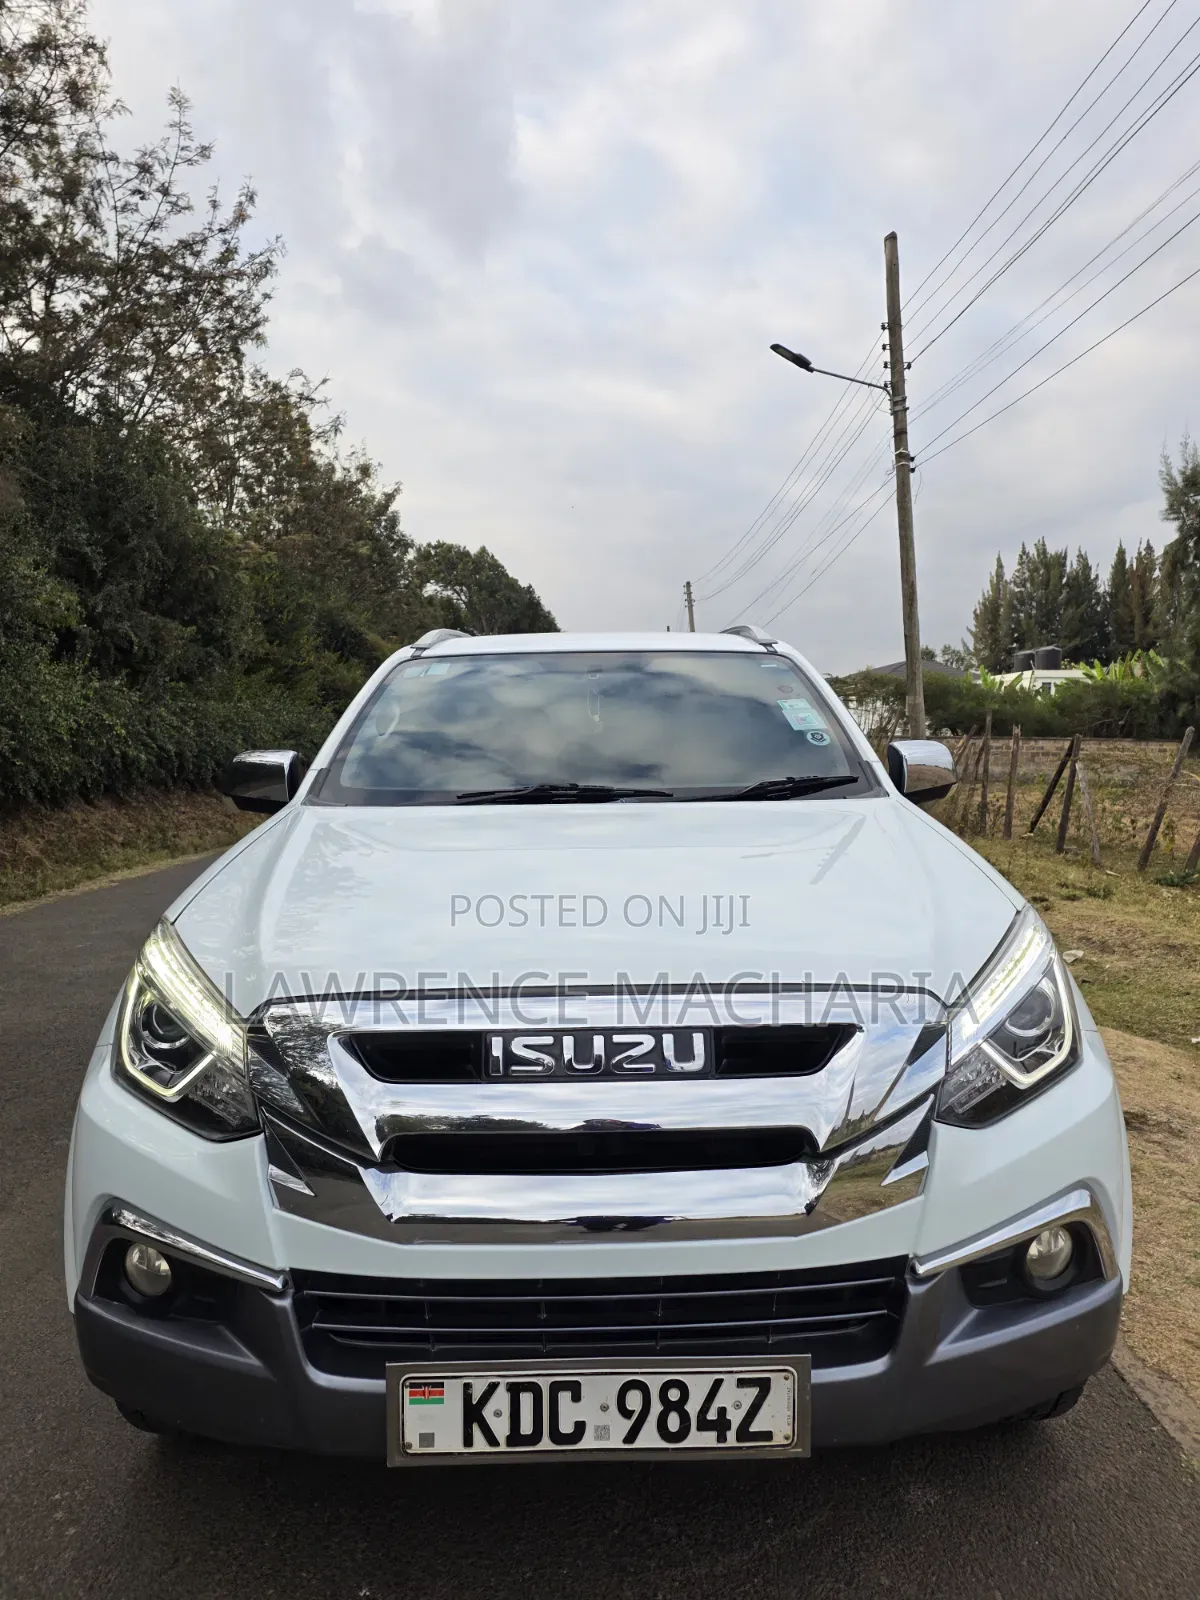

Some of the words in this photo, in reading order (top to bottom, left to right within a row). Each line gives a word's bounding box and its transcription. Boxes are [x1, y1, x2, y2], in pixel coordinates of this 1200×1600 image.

[490, 1032, 706, 1077] ISUZU
[462, 1380, 587, 1448] KDC
[616, 1376, 774, 1445] 984Z
